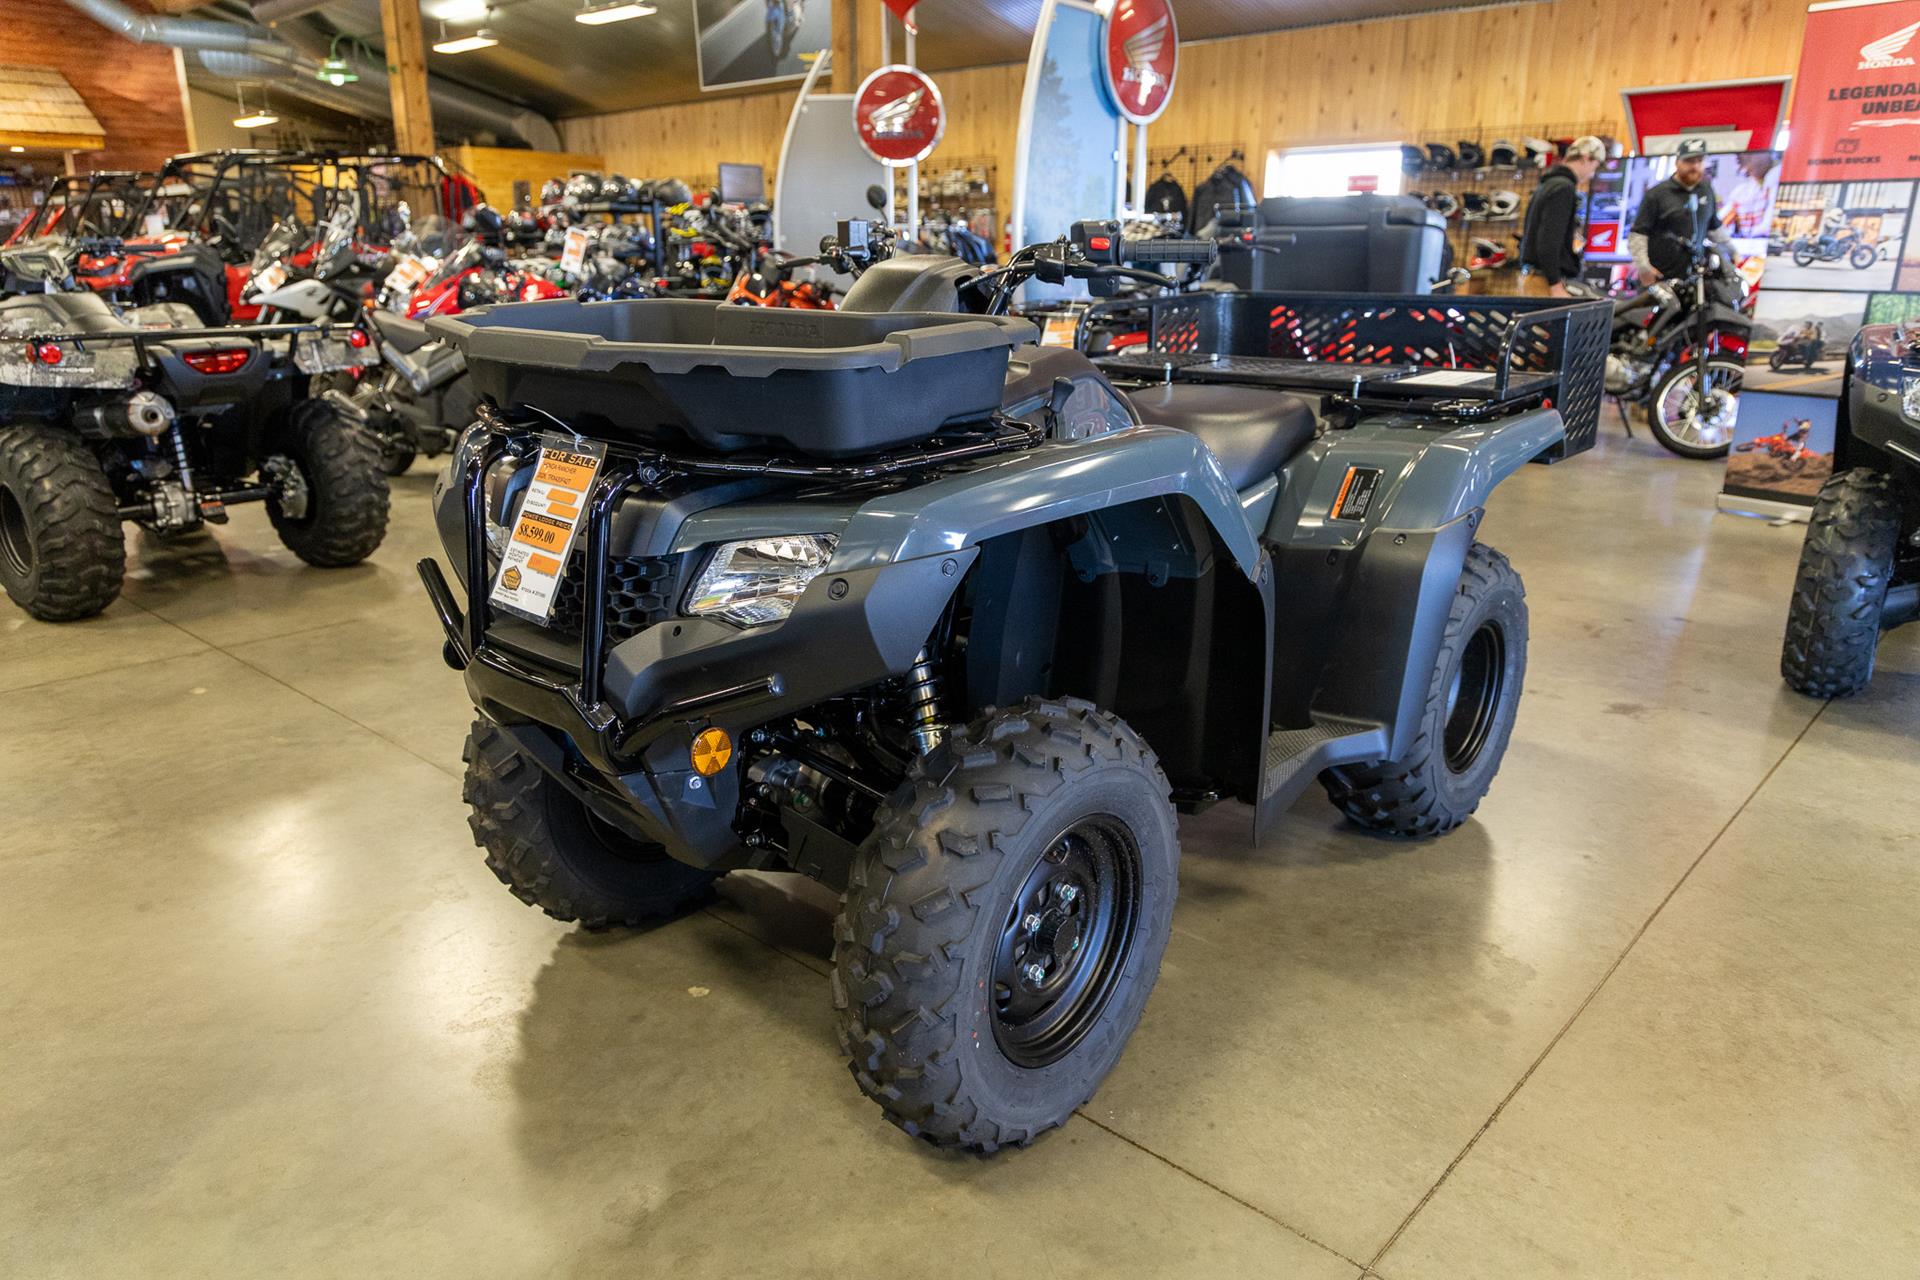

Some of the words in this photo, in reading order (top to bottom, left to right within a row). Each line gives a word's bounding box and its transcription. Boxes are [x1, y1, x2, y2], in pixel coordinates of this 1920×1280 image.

[1857, 57, 1916, 70] HONDA
[1828, 82, 1920, 101] LEGENDA
[543, 447, 567, 463] FOR
[568, 453, 597, 469] SALE
